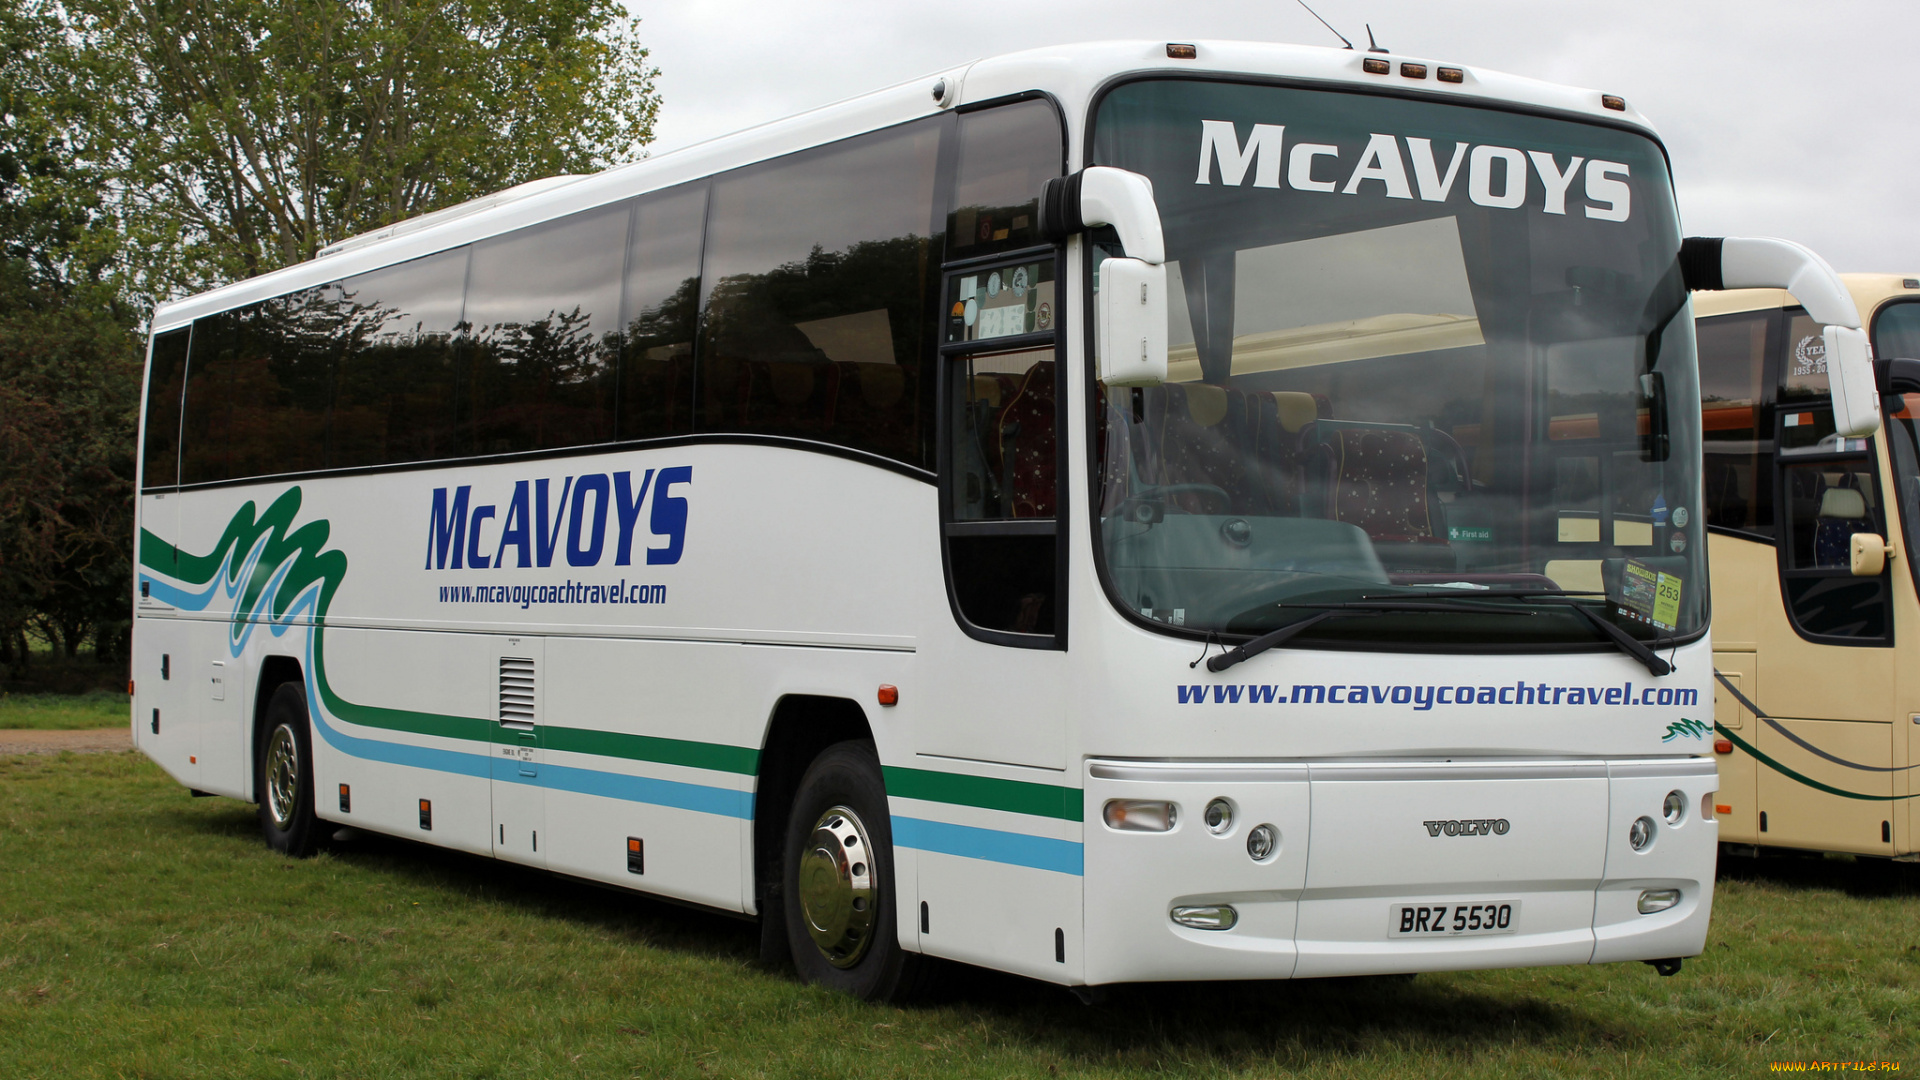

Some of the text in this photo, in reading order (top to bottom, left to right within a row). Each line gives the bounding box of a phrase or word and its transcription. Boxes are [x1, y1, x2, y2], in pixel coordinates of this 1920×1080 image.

[1195, 119, 1631, 223] McAVOYS
[1806, 345, 1825, 355] YEA
[1793, 366, 1810, 376] 1955
[425, 465, 693, 570] McAVOYS
[1462, 530, 1489, 539] First aid
[439, 579, 667, 610] www.mcavoycoachtravel.com
[1659, 584, 1679, 602] 253
[1176, 681, 1698, 711] www.mcavoycoachtravel.com
[1423, 818, 1511, 837] VOLVO
[1399, 904, 1512, 933] BRZ 5530
